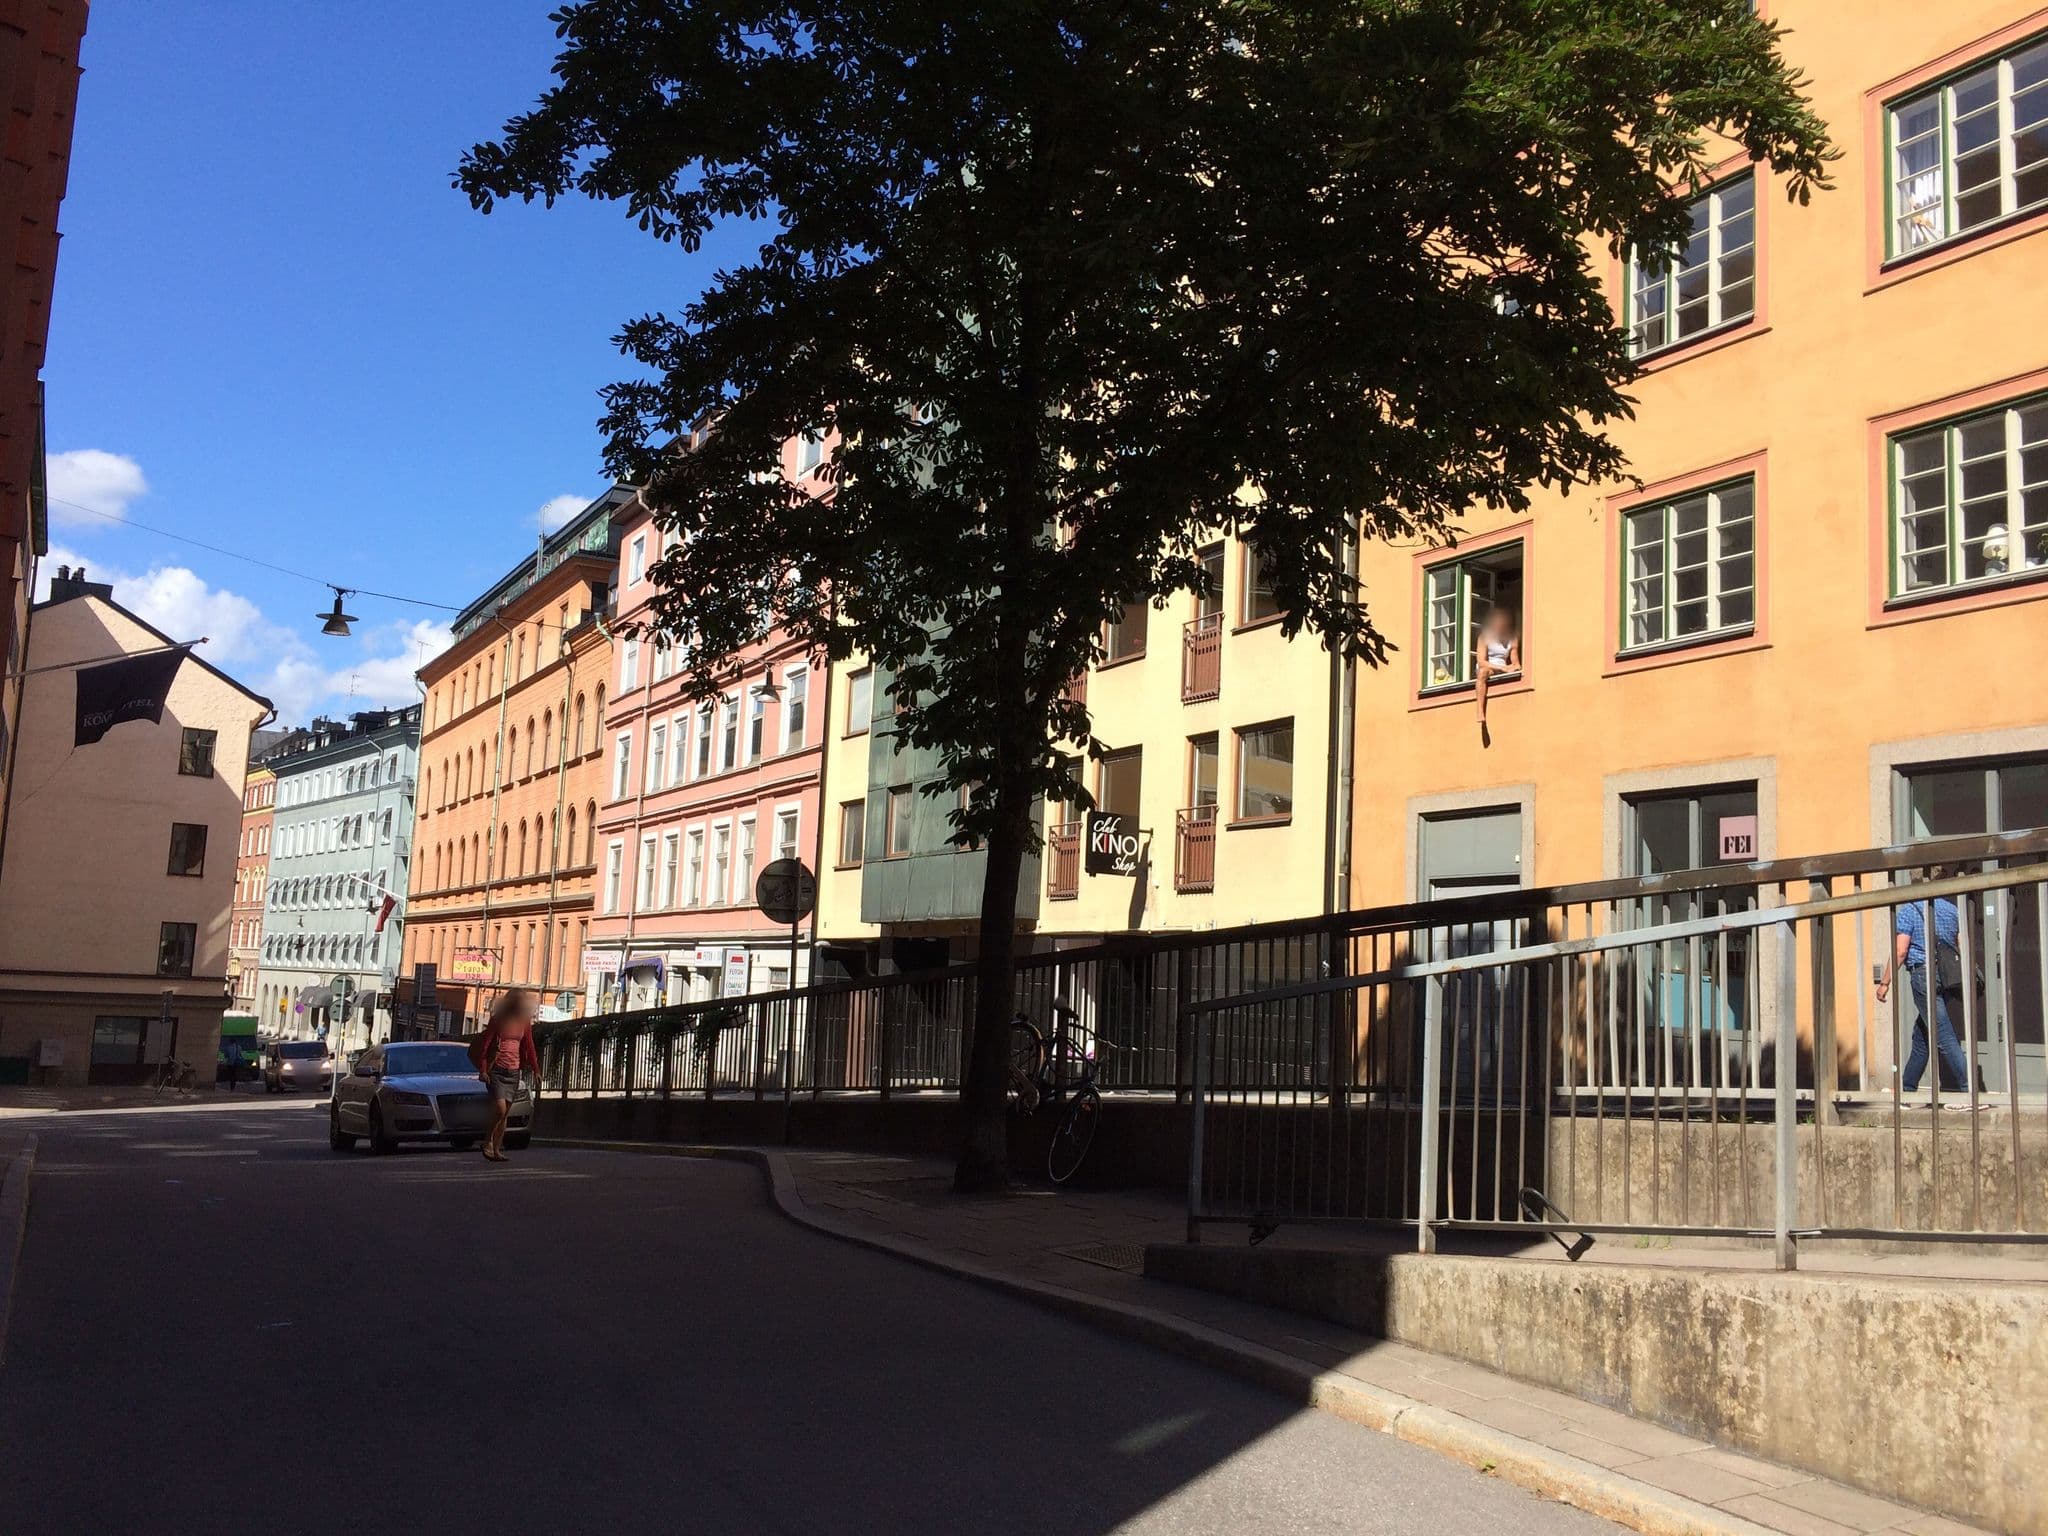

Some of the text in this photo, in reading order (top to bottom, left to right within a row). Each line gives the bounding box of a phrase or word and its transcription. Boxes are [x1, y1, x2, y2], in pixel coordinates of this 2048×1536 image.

[1093, 816, 1121, 833] Club
[1092, 832, 1138, 856] KINO
[1724, 835, 1751, 854] FEI
[1111, 854, 1136, 877] Shop
